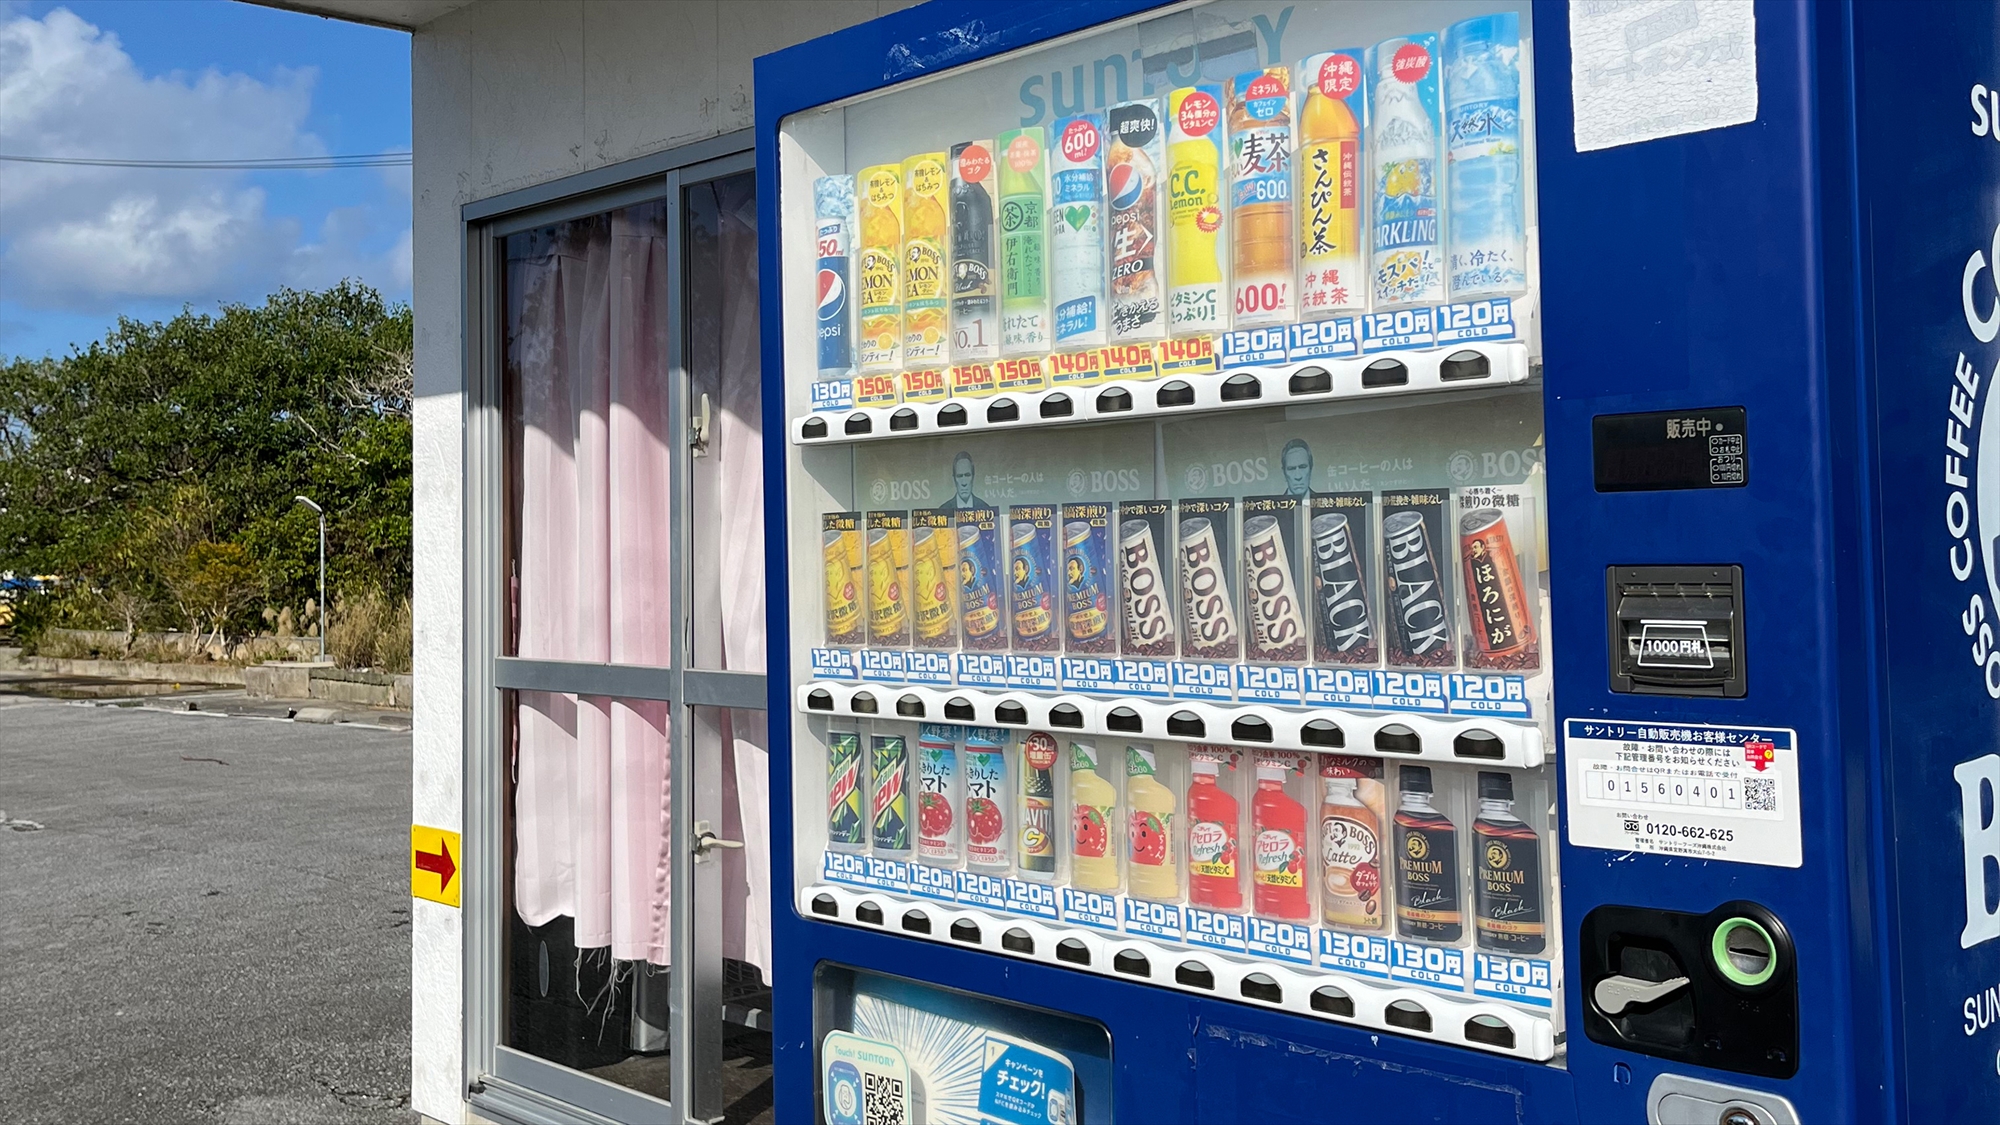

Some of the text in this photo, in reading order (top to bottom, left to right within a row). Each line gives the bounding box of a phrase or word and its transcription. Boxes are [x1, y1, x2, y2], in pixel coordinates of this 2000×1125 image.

[1324, 60, 1353, 76] 沖縄
[1396, 56, 1427, 71] 強炭酸
[1252, 84, 1278, 95] ミネラル
[1324, 76, 1352, 92] 限定
[1181, 109, 1216, 120] 34個分の
[1185, 99, 1212, 111] レモン
[1256, 107, 1273, 117] ゼロ
[1120, 118, 1154, 134] 超爽快!
[1183, 119, 1213, 130] ビタミンC
[1452, 113, 1504, 142] 天然水
[1065, 133, 1095, 154] 600
[1243, 133, 1290, 176] 麦茶
[967, 166, 981, 175] コク
[916, 181, 939, 192] はちみつ
[1065, 184, 1090, 192] ミネラル
[1171, 170, 1205, 198] C.C.
[1257, 180, 1286, 200] 600
[871, 190, 894, 202] はちみつ
[1310, 149, 1336, 255] さんぴん茶
[1004, 206, 1019, 228] 茶
[1023, 201, 1039, 228] 京都
[1374, 219, 1435, 247] ARKLING
[1114, 230, 1136, 261] 生
[877, 256, 894, 273] BOSS
[922, 247, 941, 265] BOSS
[969, 263, 987, 279] BOSS
[1006, 238, 1017, 295] 伊右衛門
[1113, 260, 1144, 281] ZERO
[1305, 269, 1339, 288] 沖縄
[1366, 311, 1429, 337] 120円
[1441, 302, 1508, 329] 120円
[1226, 329, 1285, 354] 130円
[1293, 321, 1354, 346] 120円
[1382, 337, 1409, 346] COLD
[1458, 328, 1488, 337] COLD
[1101, 346, 1151, 368] 140円
[1160, 338, 1212, 361] 140円
[1239, 353, 1264, 361] COLD
[1307, 345, 1333, 354] COLD
[997, 359, 1042, 380] 150円
[1050, 354, 1098, 373] 140円
[903, 371, 942, 390] 150円
[953, 365, 992, 385] 150円
[813, 382, 849, 399] 130円
[857, 377, 893, 396] 150円
[1667, 417, 1711, 439] 販売中
[1327, 457, 1413, 477] 缶コーヒーの人は
[1718, 455, 1735, 463] おつり
[1946, 352, 1980, 581] COFFEE
[984, 473, 1044, 485] 缶コーヒーの人は
[1091, 469, 1139, 491] BOSS
[1212, 457, 1268, 486] BOSS
[891, 480, 930, 500] BOSS
[1124, 538, 1166, 640] BOSS
[1186, 537, 1228, 641] BOSS
[1251, 536, 1296, 644] BOSS
[1316, 527, 1370, 651] BLACK
[1389, 526, 1447, 654] BLACK
[966, 598, 984, 609] BOSS
[1019, 598, 1037, 609] BOSS
[1072, 599, 1092, 610] BOSS
[1476, 564, 1512, 645] ほろにが
[1647, 640, 1704, 654] 1000円札
[813, 650, 849, 667] 120円
[863, 651, 901, 669] 120円
[908, 654, 948, 672] 120円
[960, 655, 1003, 674] 120円
[1009, 657, 1053, 677] 120円
[1064, 660, 1111, 680] 120円
[1115, 660, 1166, 682] 120円
[1174, 662, 1229, 686] 120円
[1240, 667, 1296, 689] 120円
[1307, 670, 1369, 693] 120円
[1376, 671, 1440, 697] 120円
[1453, 674, 1523, 700] 120円
[1255, 690, 1280, 698] COLD
[1392, 698, 1420, 706] COLD
[1471, 701, 1501, 710] COLD
[1584, 725, 1772, 744] サントリー自動販売機お客様センター
[1623, 743, 1730, 756] 故障・お問い合わせの際には
[1616, 752, 1740, 767] 下記管理番号をお知らせください
[1326, 767, 1351, 776] 味わい
[1023, 827, 1040, 846] C
[1192, 830, 1222, 844] アセロラ
[1349, 826, 1375, 854] BOSS
[1647, 823, 1734, 842] 0120-662-625
[1193, 843, 1221, 857] Refresh
[1257, 840, 1290, 852] アセロラ
[1326, 847, 1362, 864] Latte
[828, 853, 863, 874] 120円
[1259, 852, 1288, 865] Refresh
[1399, 856, 1442, 874] PREMIUM
[868, 859, 906, 881] 120円
[911, 865, 951, 888] 120円
[1356, 871, 1376, 882] ダブル
[1407, 872, 1430, 882] BOSS
[1479, 866, 1524, 884] PREMIUM
[877, 879, 894, 887] COLD
[922, 886, 940, 894] COLD
[958, 872, 1002, 897] 120円
[1007, 880, 1053, 905] 120円
[1487, 882, 1511, 892] BOSS
[970, 895, 989, 903] COLD
[1020, 903, 1040, 911] COLD
[1066, 890, 1114, 916] 120円
[1411, 889, 1446, 907] Black
[1079, 914, 1100, 922] COLD
[1127, 899, 1179, 926] 120円
[1491, 900, 1532, 918] Black
[1140, 924, 1162, 933] COLD
[1188, 910, 1242, 937] 120円
[1202, 934, 1226, 944] COLD
[1250, 919, 1308, 948] 120円
[1265, 945, 1290, 955] COLD
[1323, 931, 1386, 961] 130円
[1338, 958, 1366, 968] COLD
[1394, 942, 1460, 974] 130円
[1411, 970, 1440, 981] COLD
[1478, 955, 1547, 986] 130円
[1496, 984, 1526, 994] COLD
[1005, 1059, 1043, 1078] キャンペーンを
[997, 1070, 1045, 1099] チェック!
